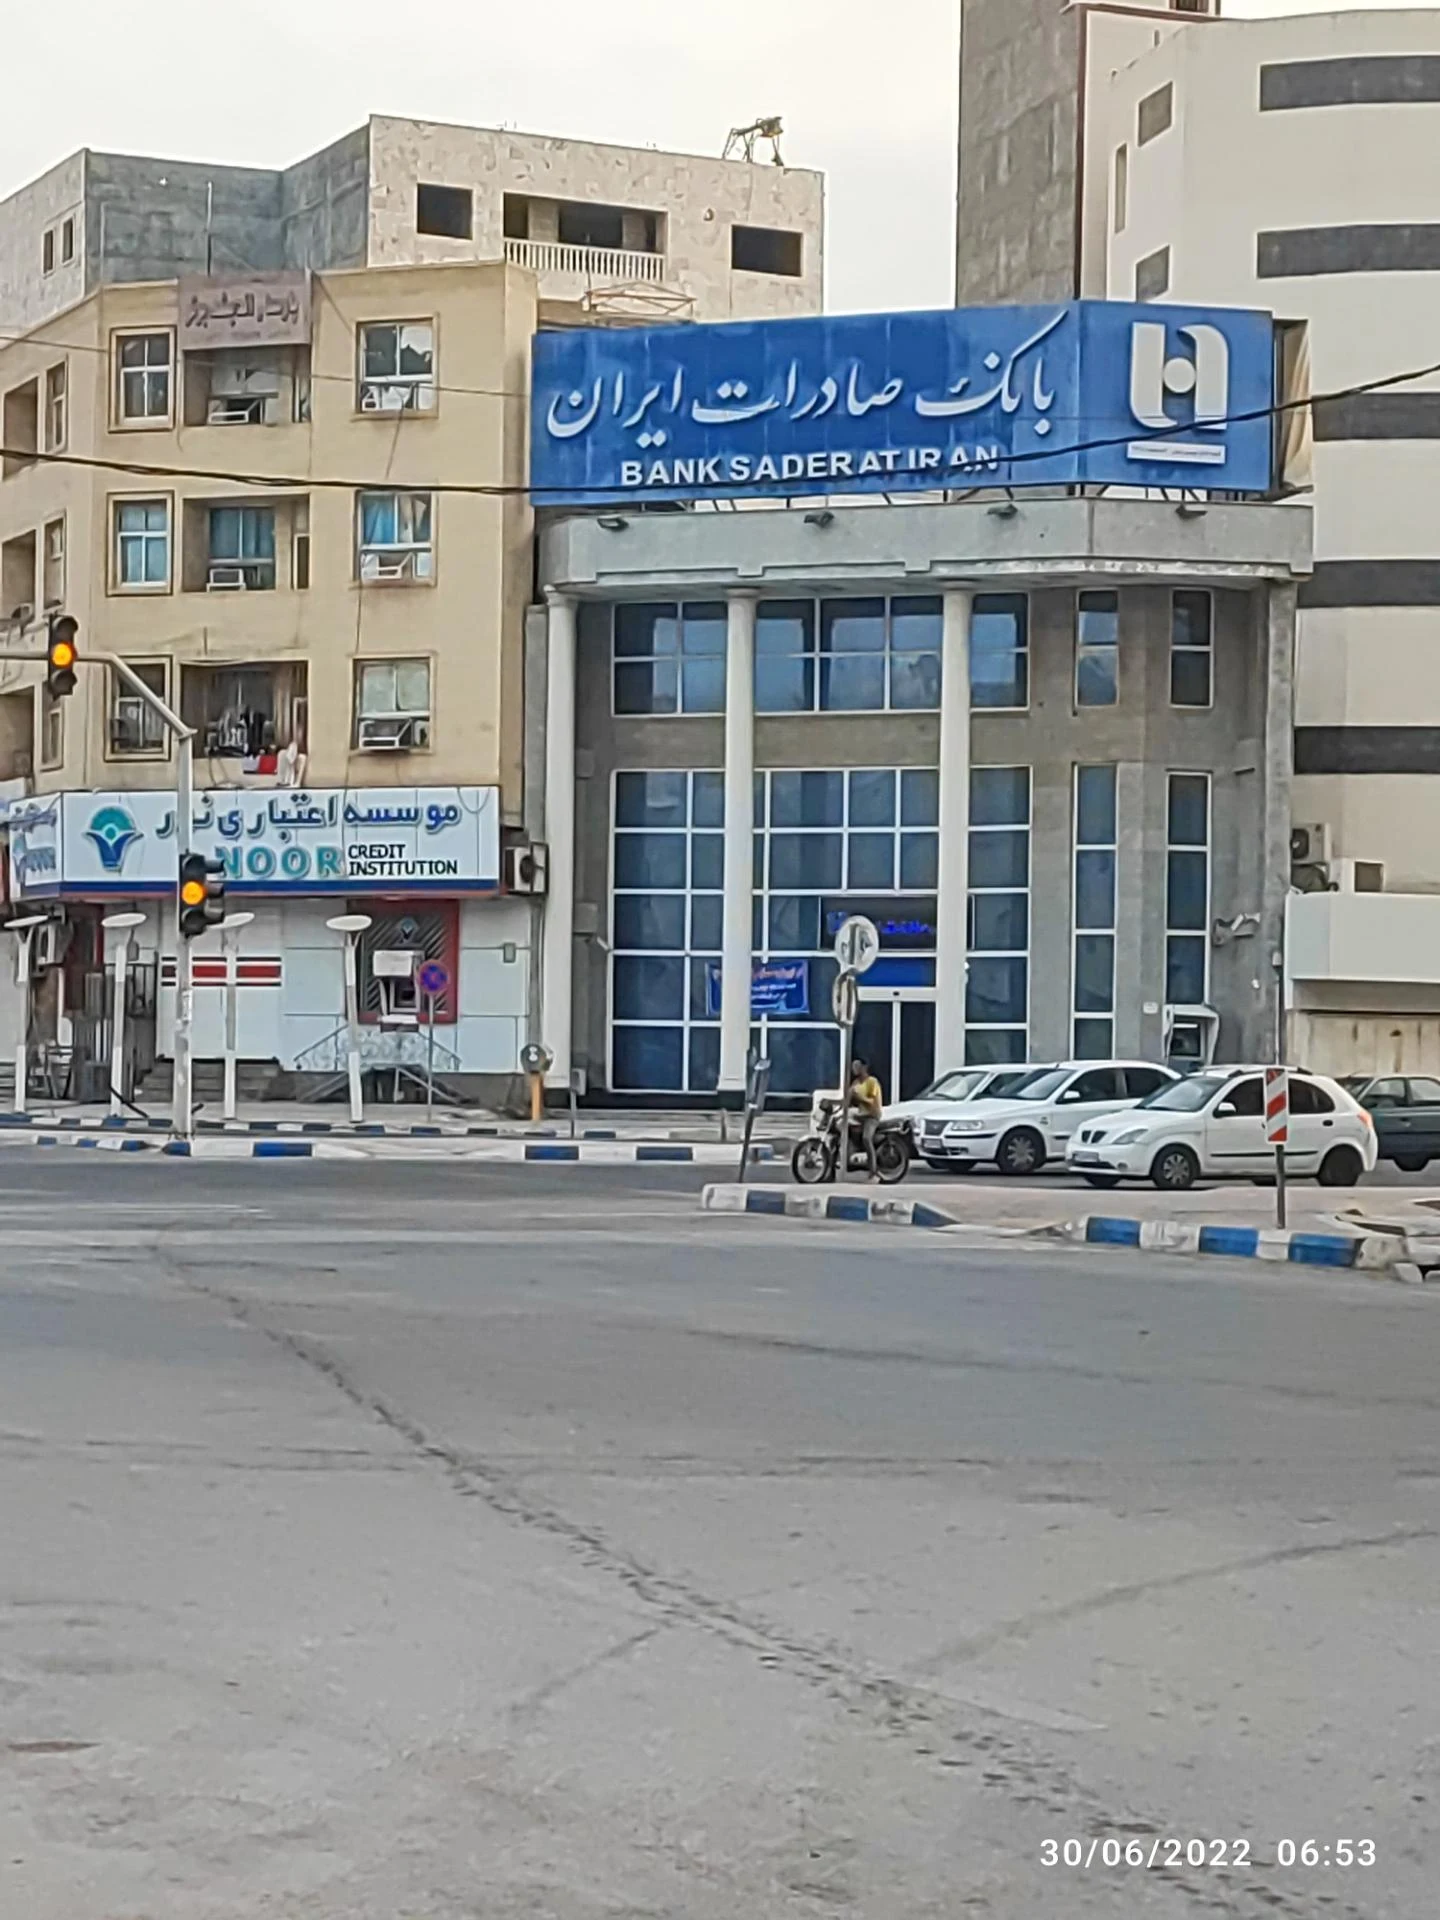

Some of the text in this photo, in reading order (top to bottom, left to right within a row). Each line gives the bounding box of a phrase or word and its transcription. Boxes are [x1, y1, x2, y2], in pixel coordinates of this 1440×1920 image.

[547, 367, 683, 449] ایران
[692, 358, 904, 424] صادرات
[620, 444, 999, 486] BANK SADERAT IRAN
[155, 793, 462, 843] موسسه اعتباری نر
[215, 846, 344, 879] NOOR
[347, 844, 406, 859] CREDIT
[348, 859, 458, 876] INSTITUTION
